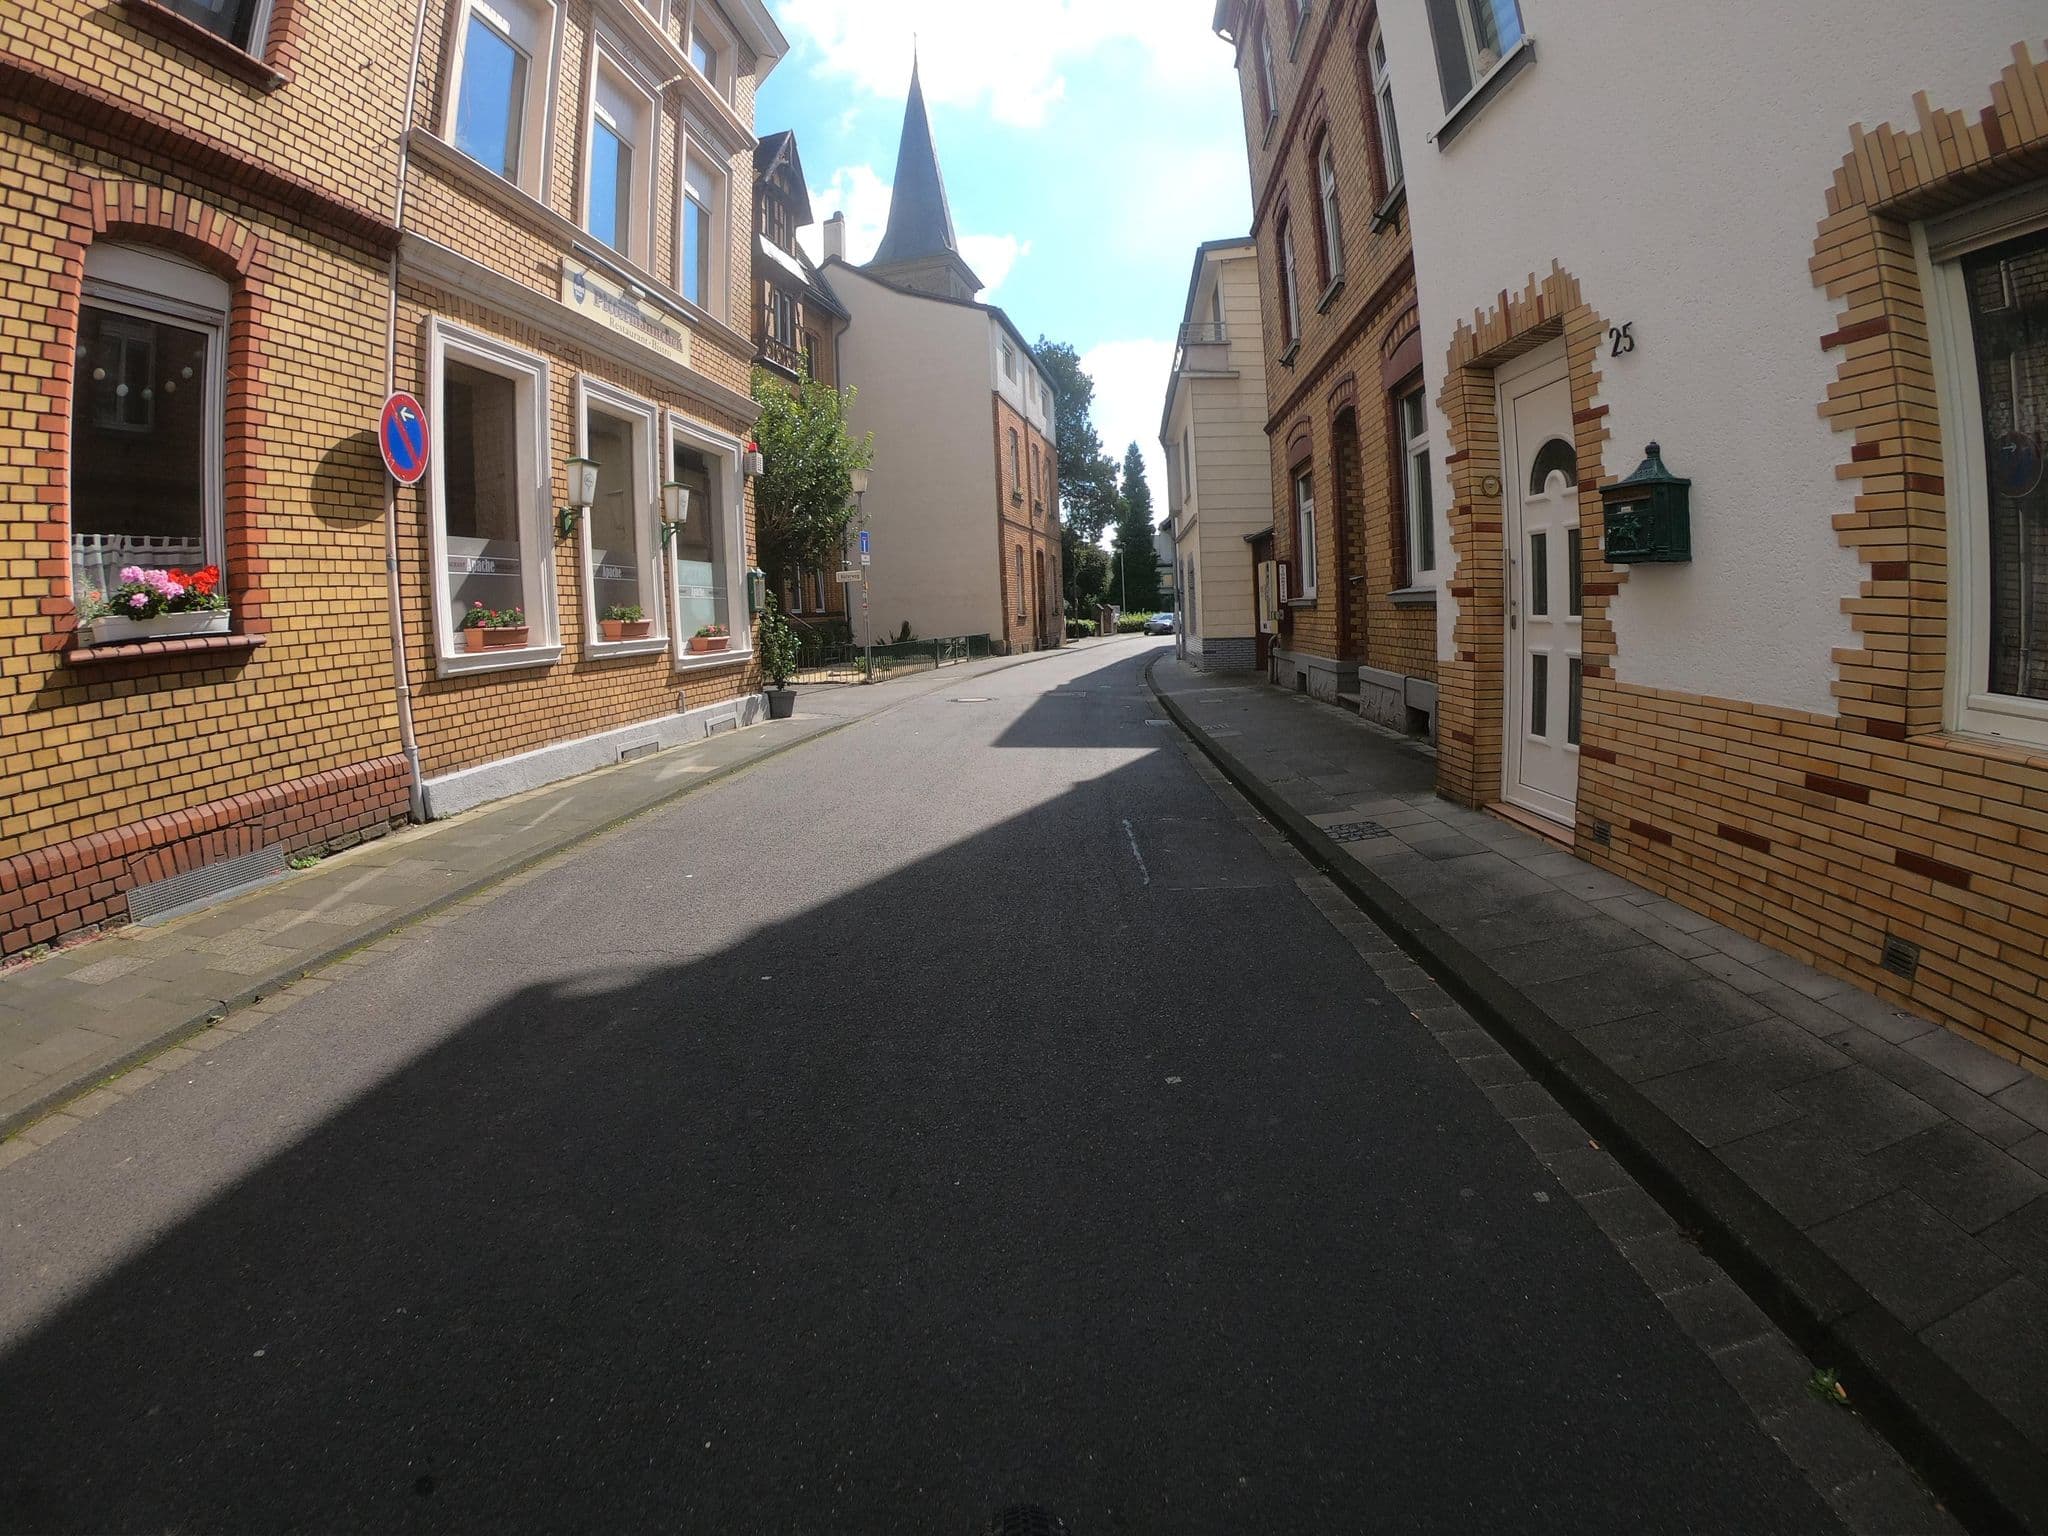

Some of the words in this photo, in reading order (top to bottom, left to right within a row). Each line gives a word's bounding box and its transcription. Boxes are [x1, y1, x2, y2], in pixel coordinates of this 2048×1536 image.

[1609, 321, 1634, 357] 25
[466, 558, 495, 574] Apache
[602, 566, 622, 578] Apache
